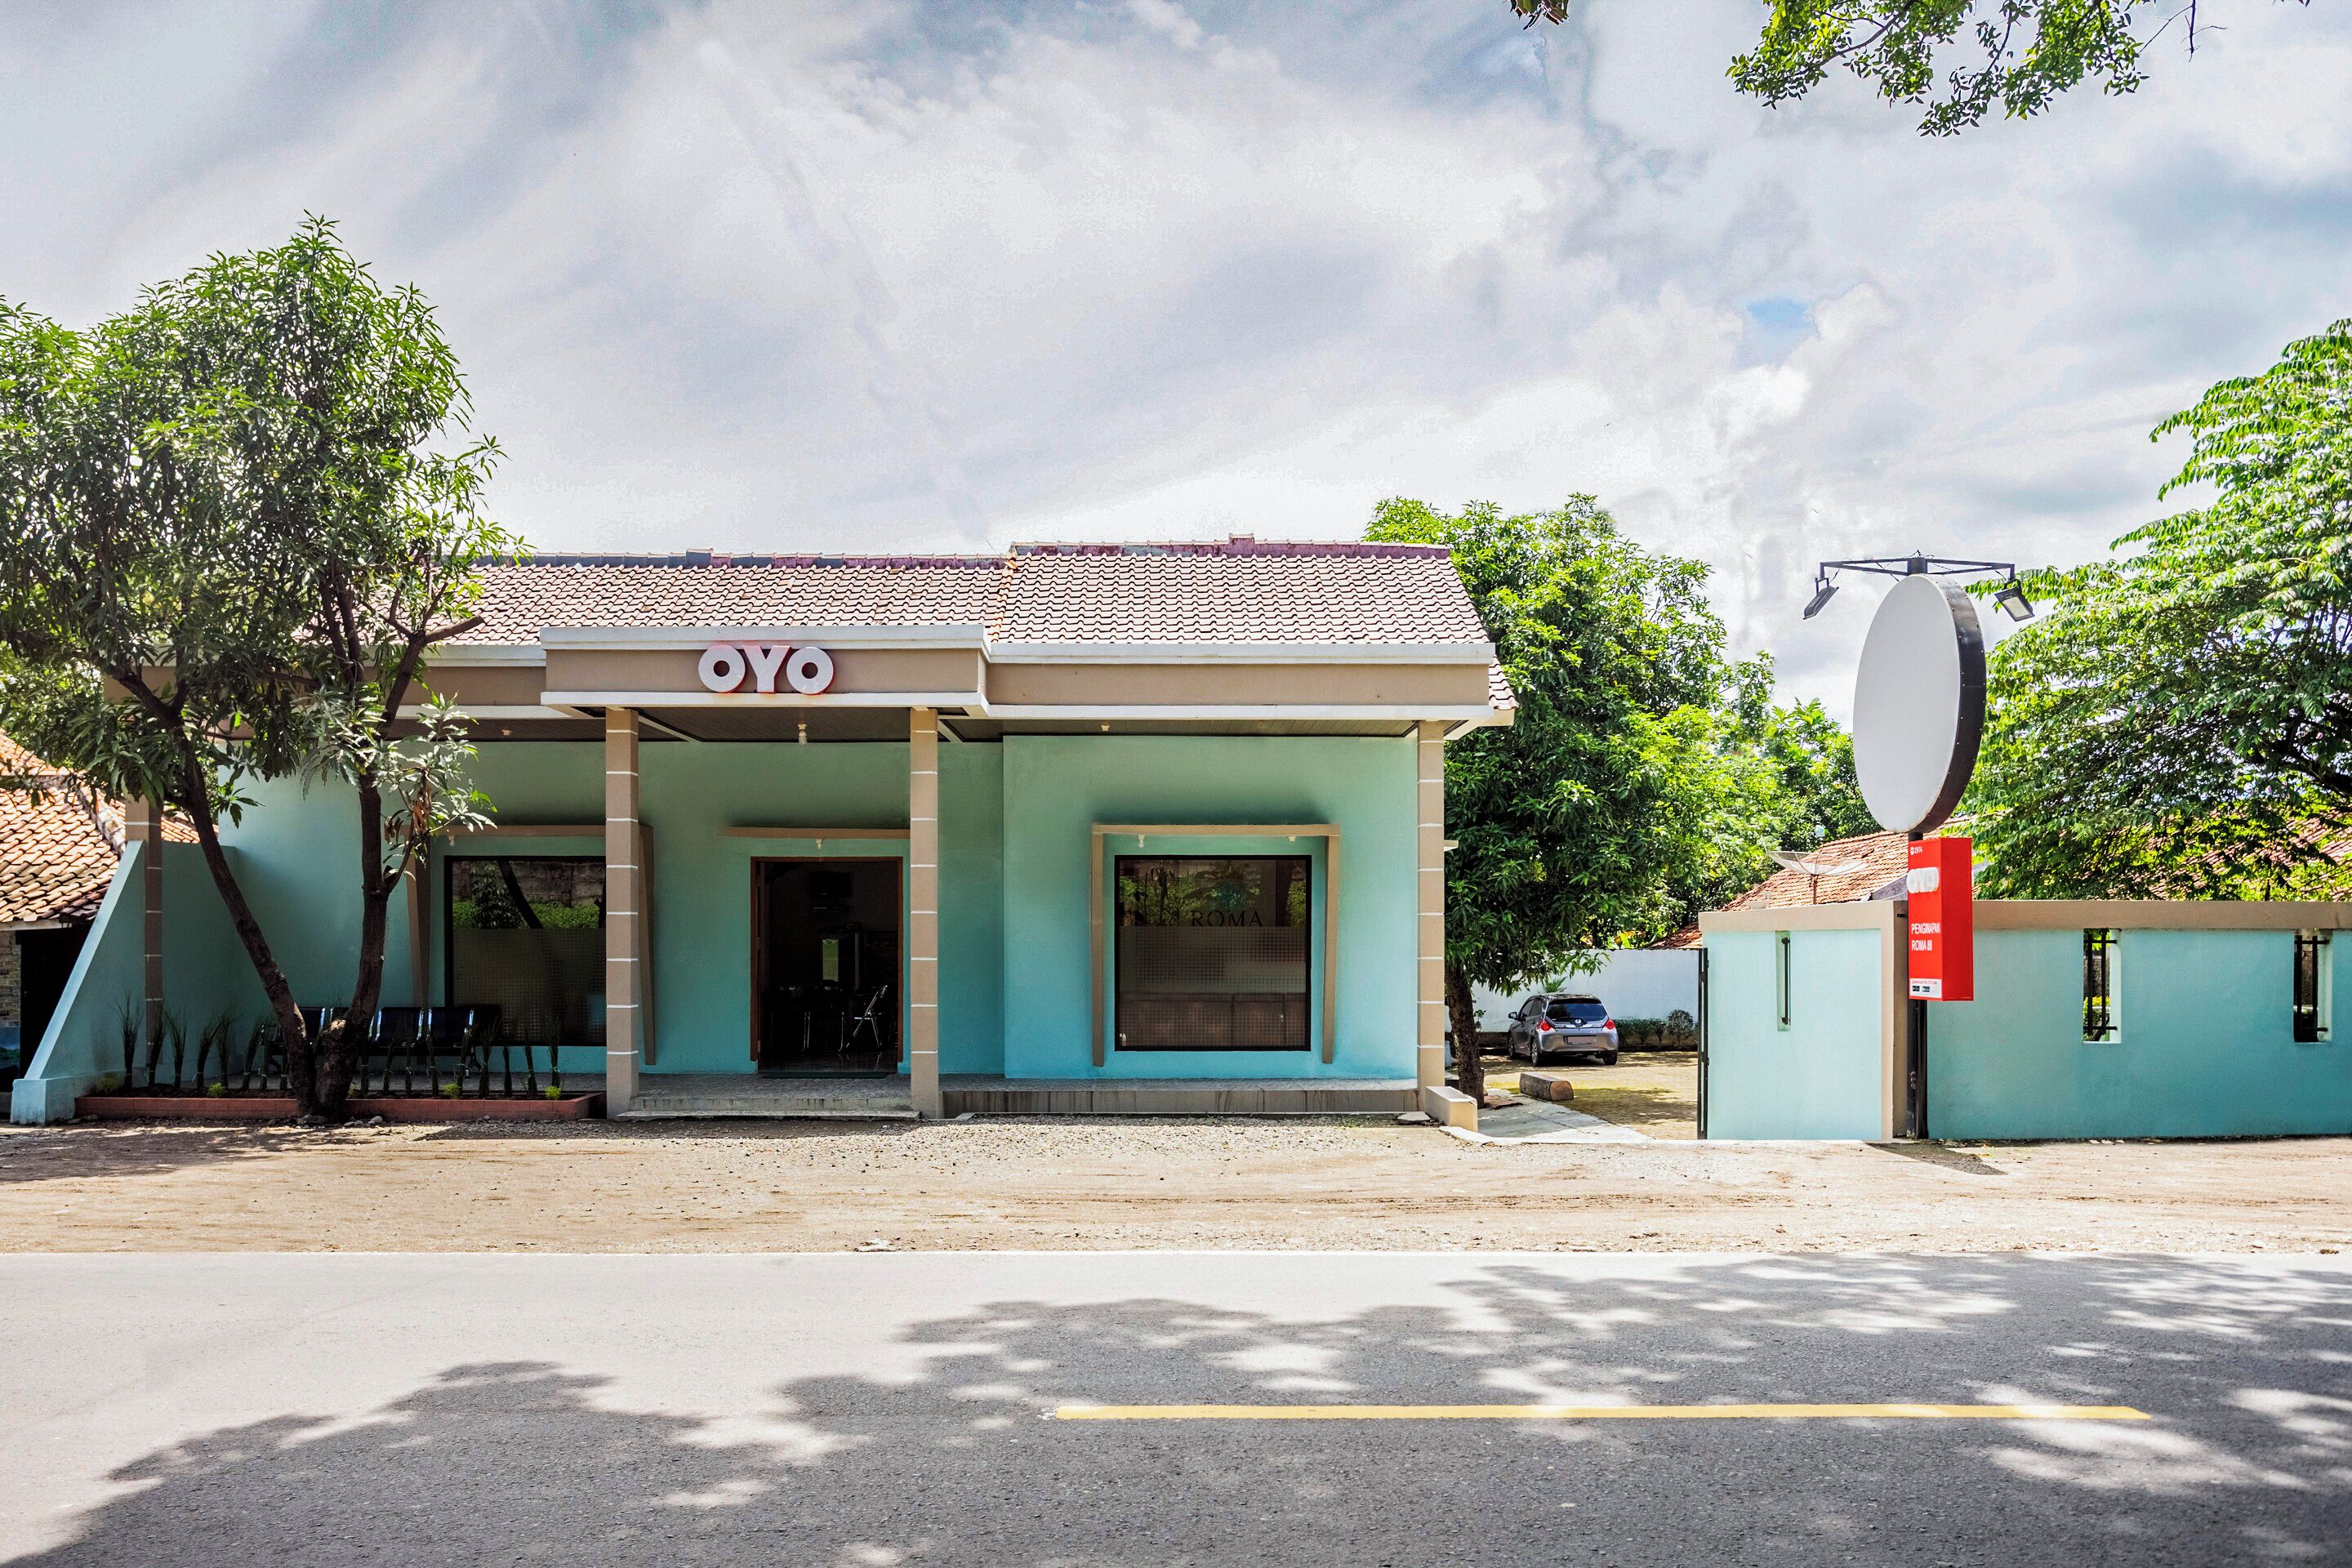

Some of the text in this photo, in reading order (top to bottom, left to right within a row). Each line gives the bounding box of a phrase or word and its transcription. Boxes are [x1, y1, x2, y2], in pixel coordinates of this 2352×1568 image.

[698, 644, 835, 695] OYO
[1191, 910, 1263, 927] ROMA
[1911, 923, 1940, 934] PENGINAPAN
[1911, 939, 1927, 951] ROMA
